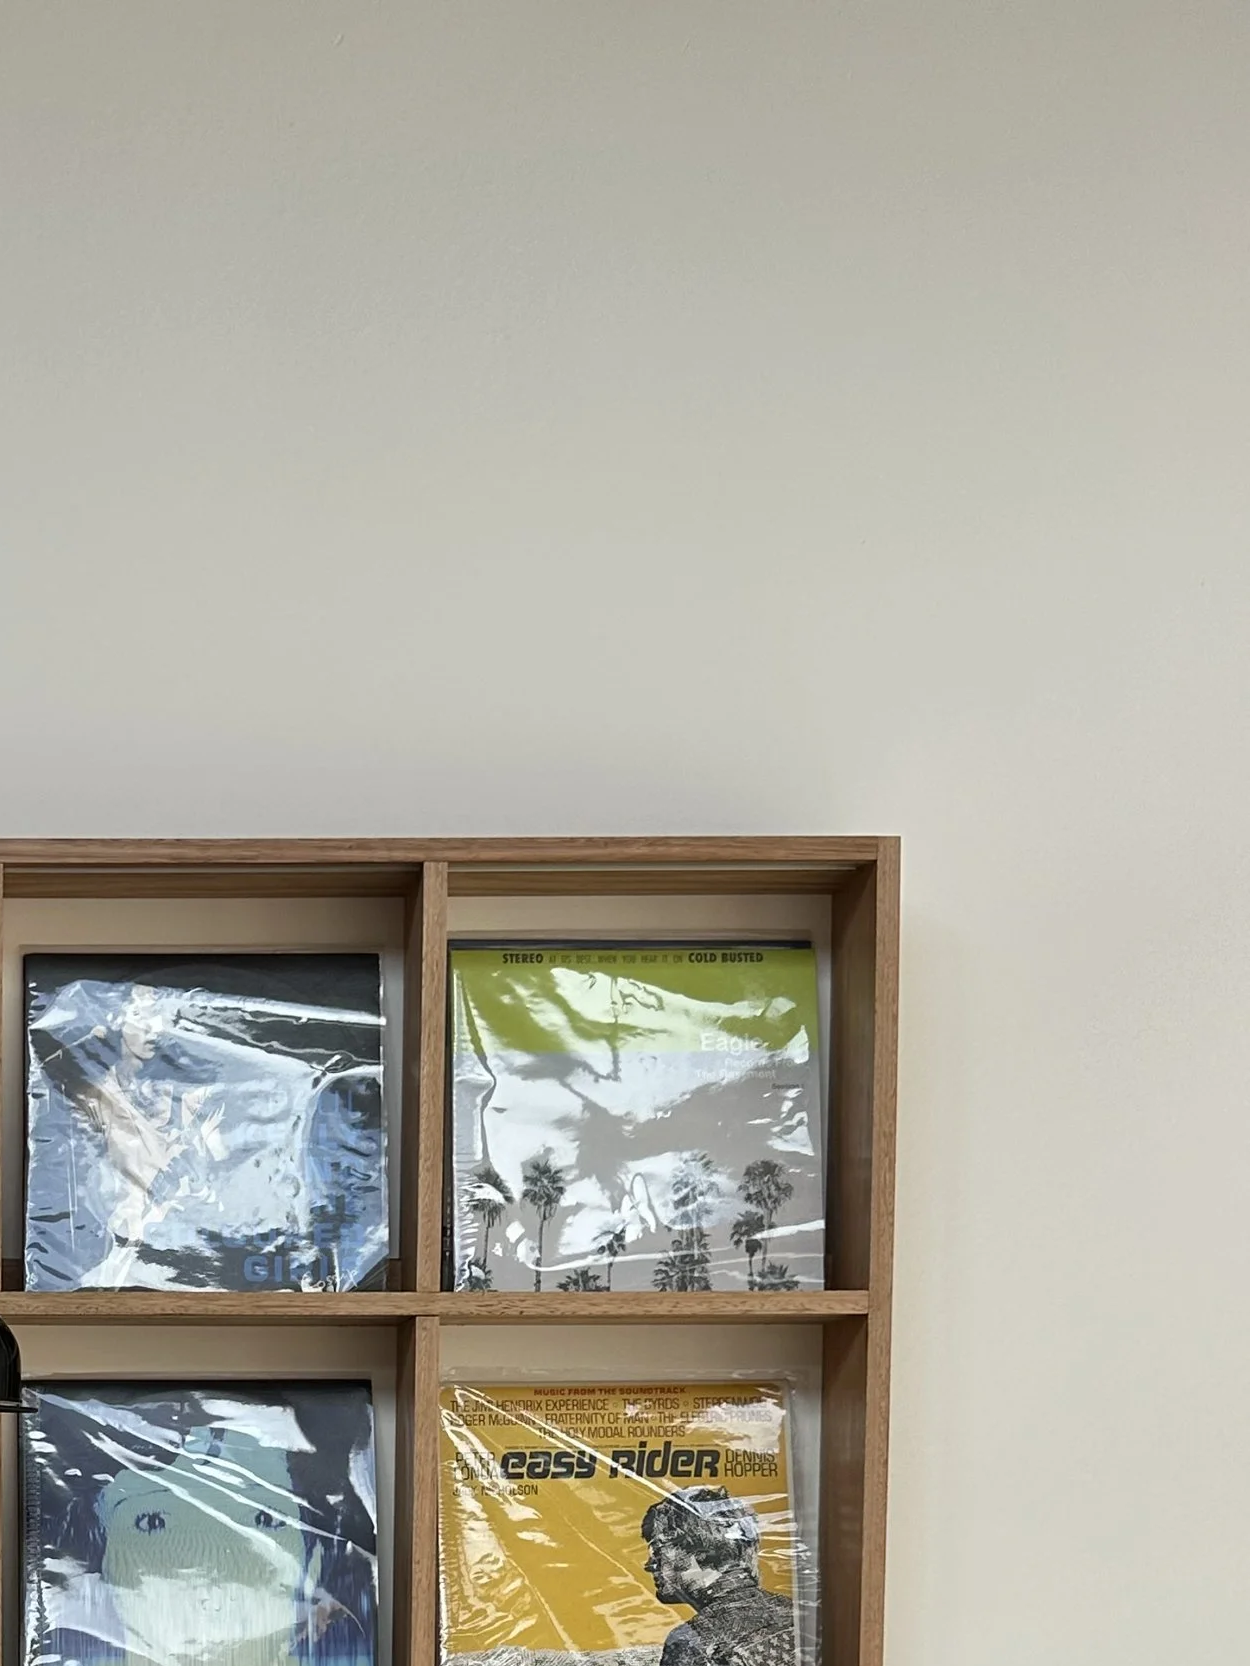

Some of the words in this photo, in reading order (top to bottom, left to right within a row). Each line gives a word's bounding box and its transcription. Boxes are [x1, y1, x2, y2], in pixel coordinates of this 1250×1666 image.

[502, 953, 543, 964] STEREO
[688, 953, 717, 963] COLD
[721, 953, 764, 963] BUSTED
[619, 1387, 686, 1396] SOUNDTRACK
[450, 1401, 470, 1412] THE
[499, 1400, 543, 1412] HENDRIX
[545, 1399, 609, 1411] EXPERIENCE
[644, 1398, 680, 1410] BYRDS
[545, 1413, 607, 1425] FRATERNITY
[609, 1412, 622, 1424] OF
[587, 1427, 625, 1438] MODAL
[627, 1426, 686, 1438] ROUNDERS
[725, 1450, 776, 1463] DENNIS
[501, 1450, 597, 1480] easy
[724, 1463, 779, 1477] HOPPER
